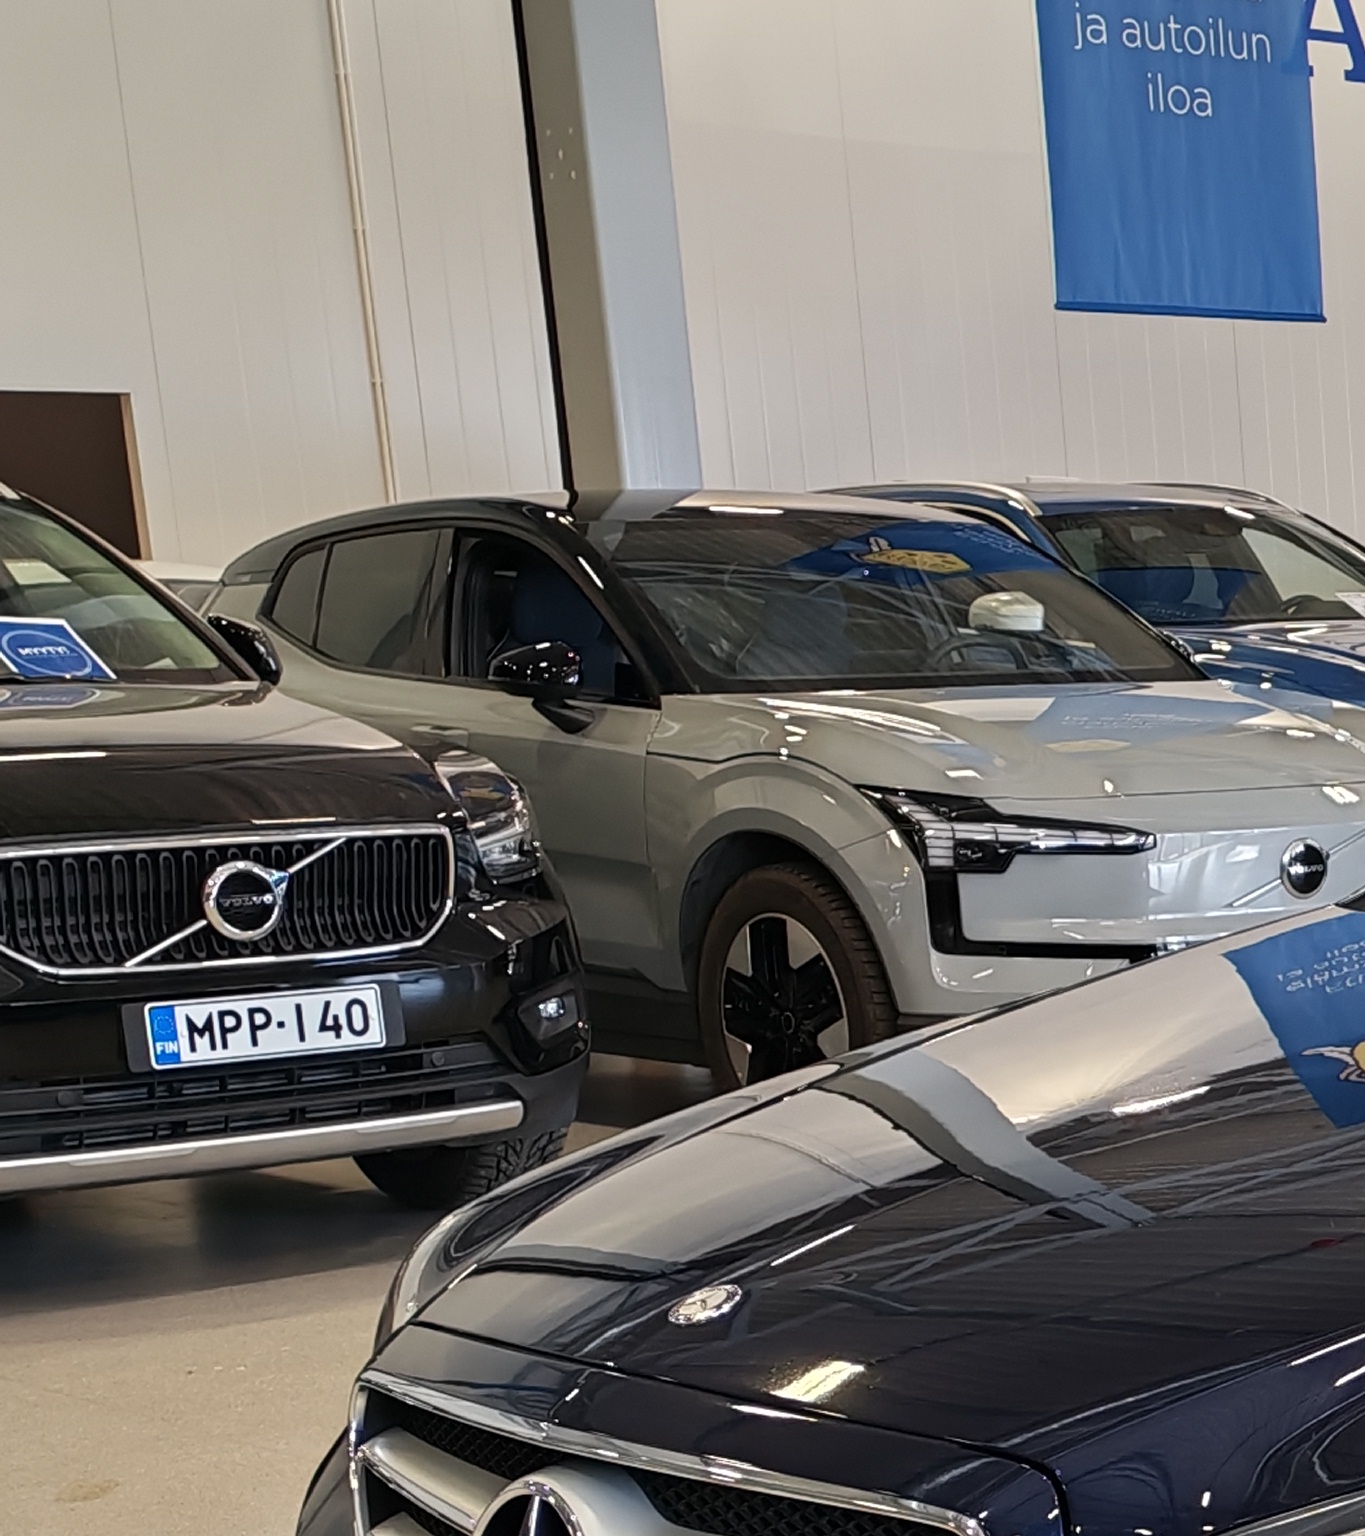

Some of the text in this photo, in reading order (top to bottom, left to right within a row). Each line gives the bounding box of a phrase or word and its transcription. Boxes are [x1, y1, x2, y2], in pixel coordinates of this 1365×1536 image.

[1074, 2, 1272, 63] ja autoilun
[1147, 72, 1213, 117] iloa
[1288, 863, 1324, 875] VOLVO
[155, 1040, 179, 1055] FIN
[185, 997, 370, 1053] MPP-140
